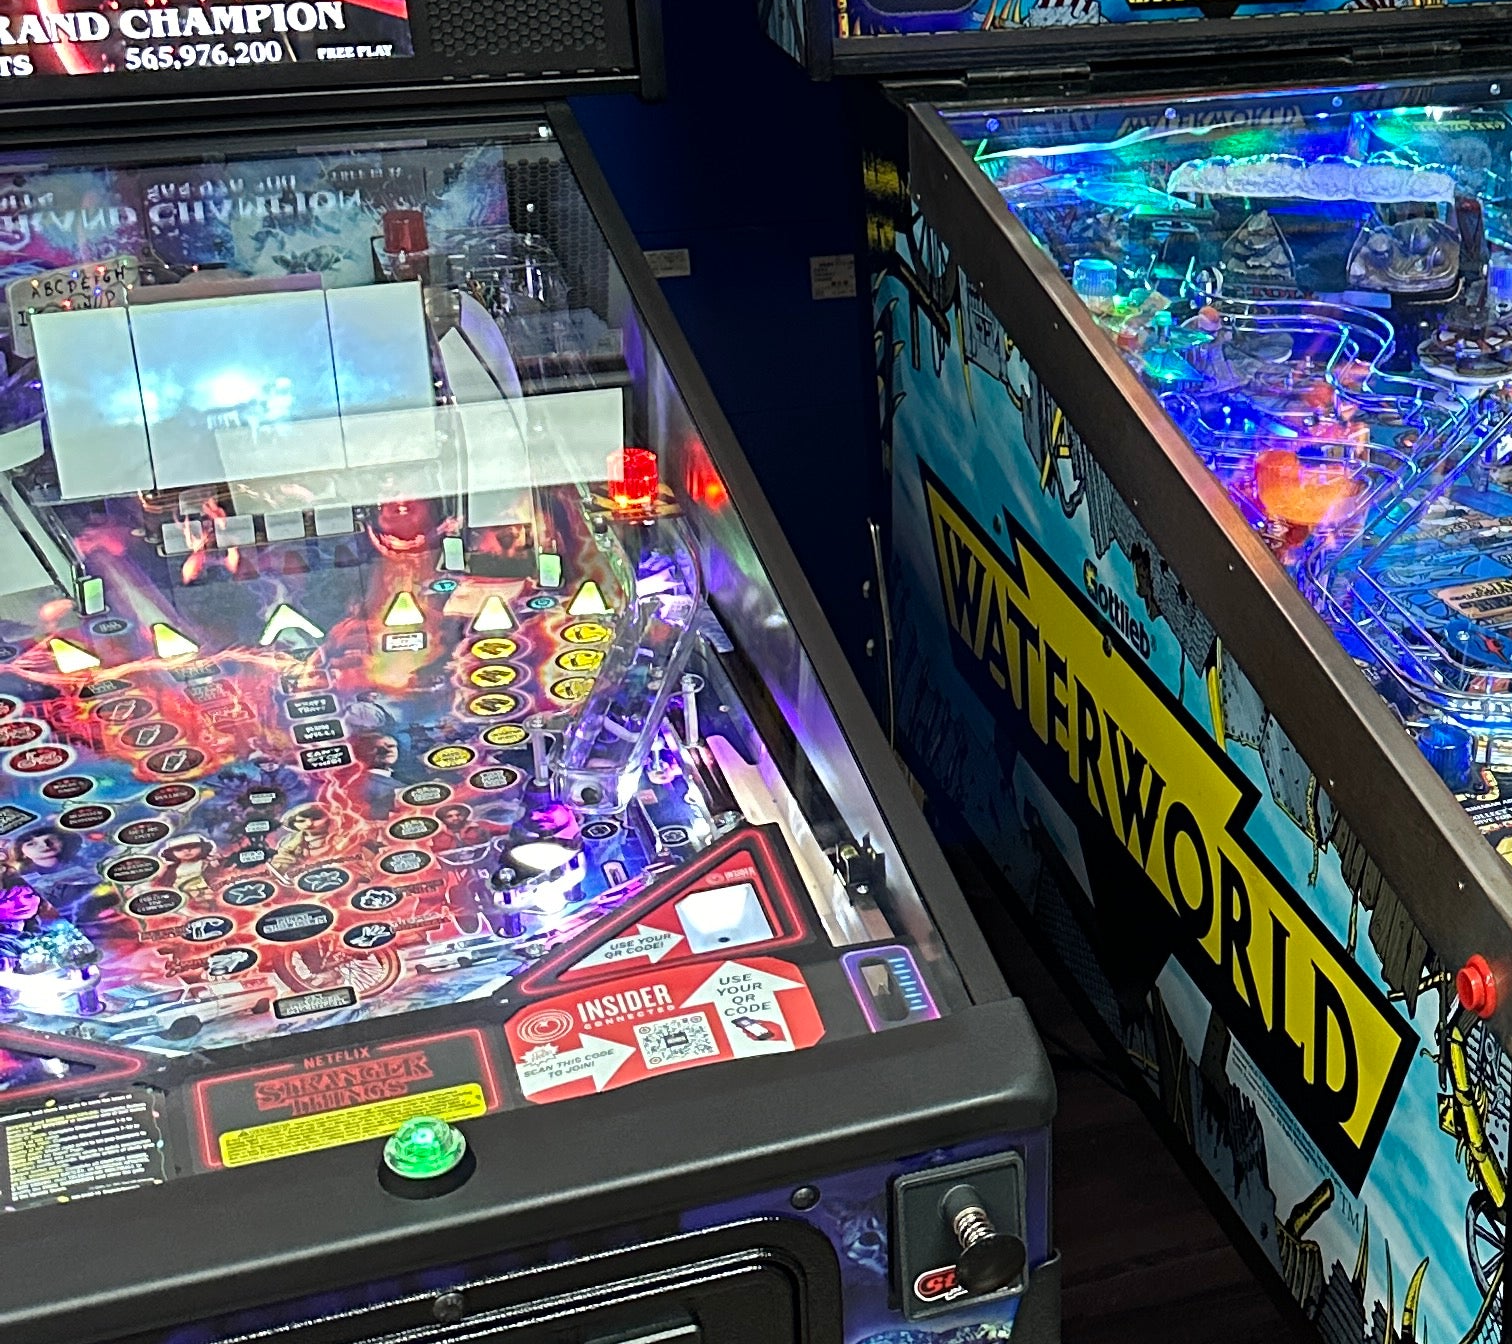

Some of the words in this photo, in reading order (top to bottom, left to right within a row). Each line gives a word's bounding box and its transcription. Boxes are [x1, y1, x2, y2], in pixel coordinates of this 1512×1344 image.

[119, 0, 347, 41] CHAMPION
[125, 39, 284, 72] 565,976,200
[317, 46, 355, 61] FREE
[357, 44, 394, 59] PLAY
[1082, 560, 1153, 658] Gottlieb
[942, 513, 1361, 1130] WATERWORLD
[604, 947, 625, 961] QR
[626, 941, 665, 955] CODE!
[610, 937, 637, 952] USE
[638, 932, 672, 946] YOUR
[716, 982, 763, 998] YOUR
[719, 972, 752, 986] USE
[576, 983, 673, 1024] INSIDER
[724, 1001, 772, 1017] CODE
[732, 992, 756, 1006] QR
[584, 1004, 677, 1031] CONNECTED
[303, 1046, 372, 1070] NETFLIX
[523, 1063, 556, 1079] SCAN
[558, 1057, 582, 1072] THIS
[584, 1049, 615, 1064] CODE
[254, 1050, 434, 1112] STRANGER
[547, 1068, 563, 1080] TO
[291, 1078, 411, 1117] THINGS
